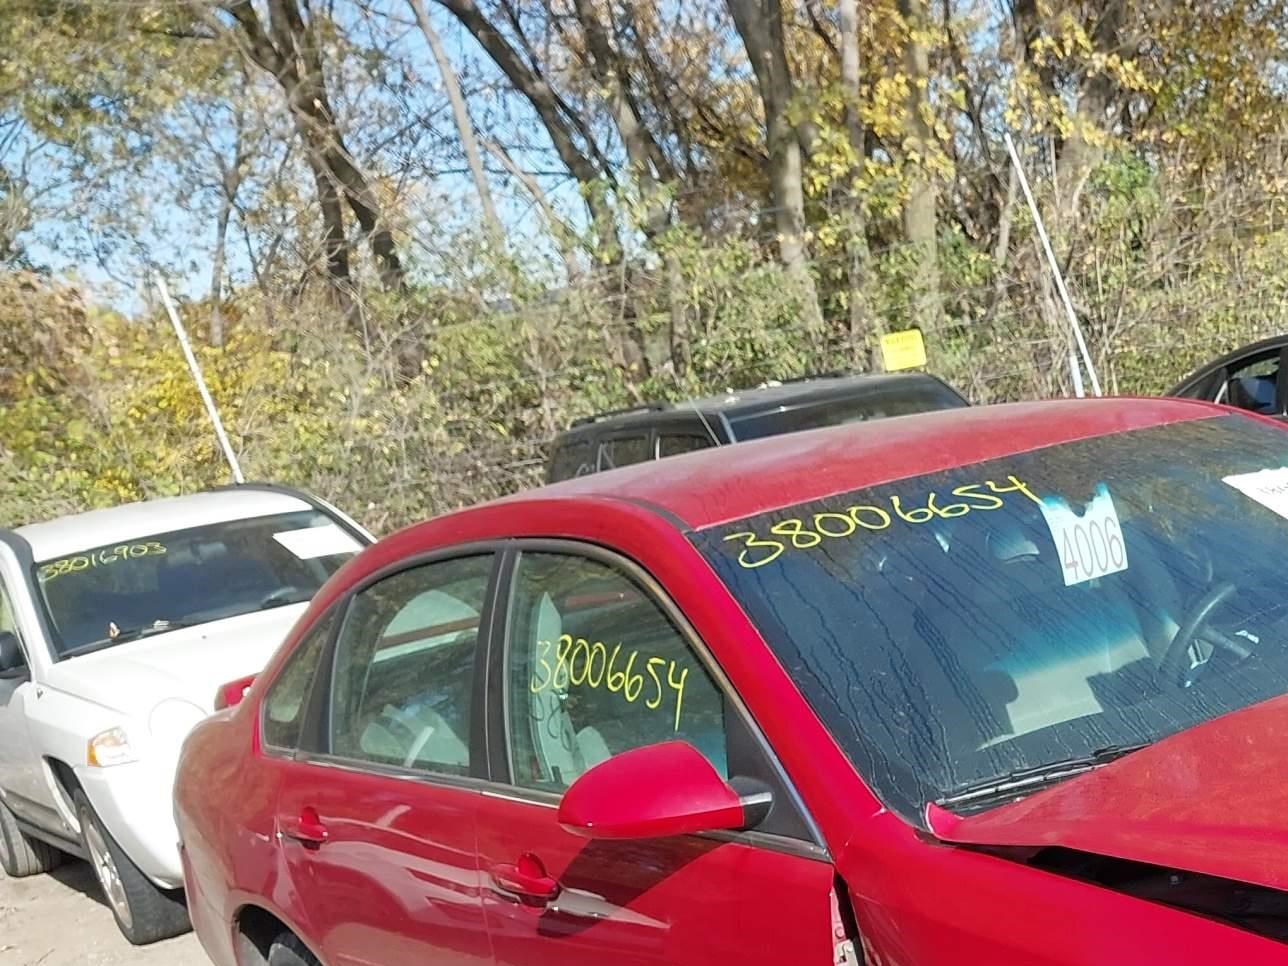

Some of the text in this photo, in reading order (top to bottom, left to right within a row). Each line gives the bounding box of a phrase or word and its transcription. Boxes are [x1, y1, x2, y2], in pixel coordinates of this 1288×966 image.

[723, 475, 1043, 568] 38006654
[1062, 516, 1124, 581] 4006
[37, 542, 167, 582] 38016903
[530, 634, 688, 732] 38006654
